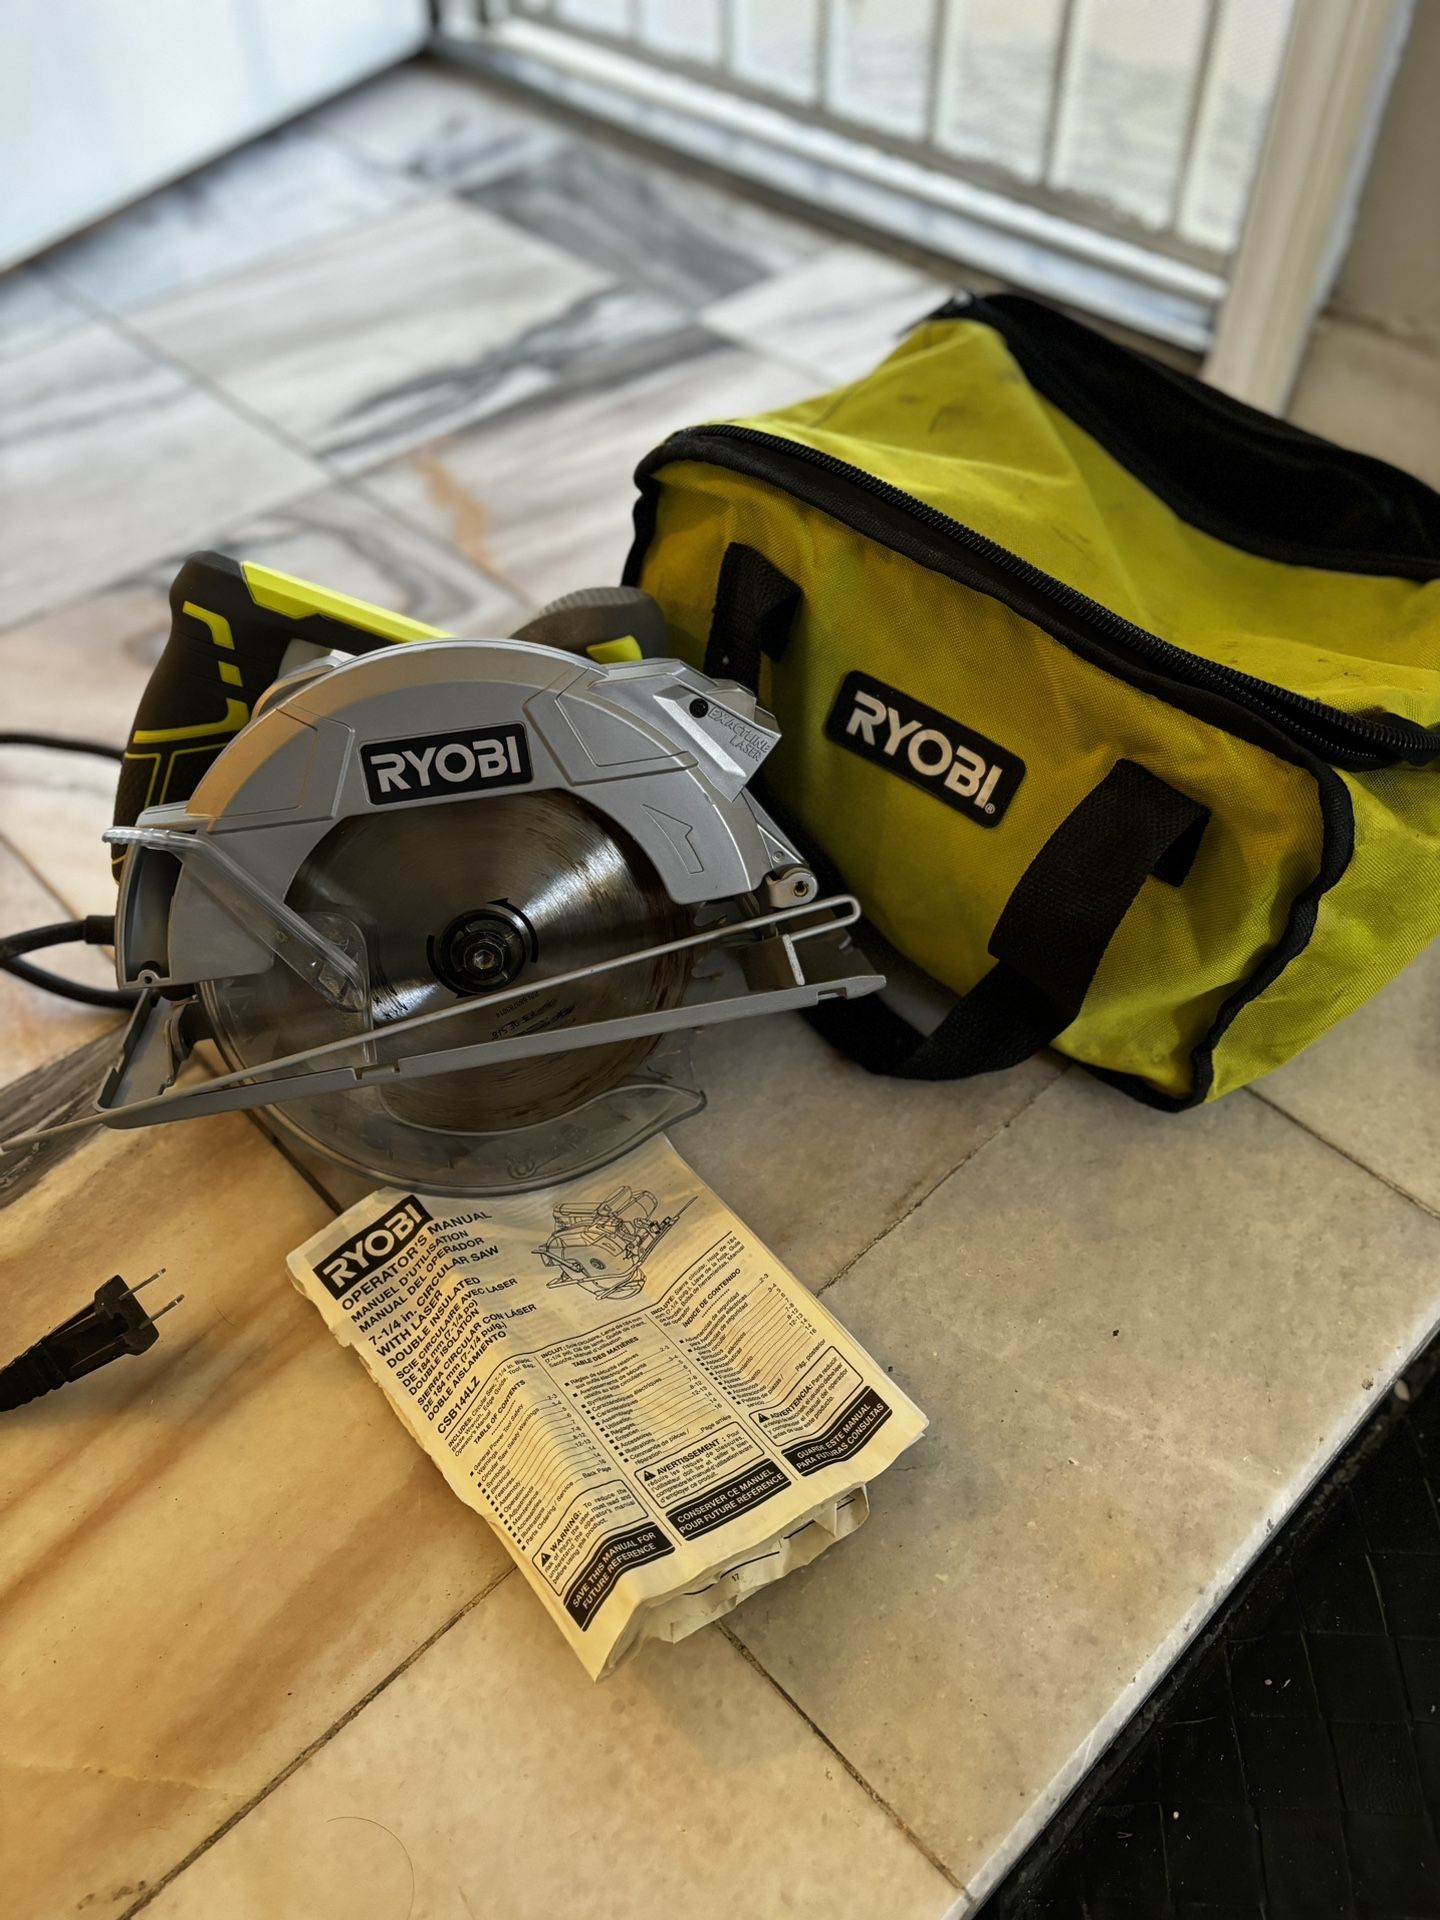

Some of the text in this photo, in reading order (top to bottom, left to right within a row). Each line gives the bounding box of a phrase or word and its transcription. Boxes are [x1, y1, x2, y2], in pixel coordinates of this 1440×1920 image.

[370, 736, 521, 793] RYOBI
[729, 734, 761, 761] LASER
[846, 690, 1002, 808] RYOBI
[323, 1203, 422, 1288] RYOBI
[342, 1211, 492, 1310] OPERATOR'S MANUAL
[351, 1230, 468, 1322] MANUEL D'UTILISATION
[359, 1237, 484, 1332] MANUAL DEL OPERADOR
[369, 1245, 499, 1346] 7-1/4 in. CIRCULAR SAW
[707, 1268, 740, 1300] CONTENIDO
[377, 1291, 443, 1356] WITH LASER
[386, 1276, 480, 1368] DOUBLE INSULATED
[396, 1278, 517, 1379] SCIE CIRCULAIRE AVEC LASER
[403, 1299, 478, 1387] DE 184 mm (7-1/4 po)
[409, 1309, 480, 1395] DOUBLE ISOLATION
[418, 1303, 537, 1406] SIERRA CIRCULAR CON LÁSER
[422, 1321, 507, 1413] DE 184 mm (7-1/4 pulg.)
[427, 1331, 506, 1421] DOBLE AISLAMIENTO
[572, 1357, 592, 1367] TABLE
[606, 1337, 639, 1355] MATIÈRES
[437, 1376, 480, 1433] CSB144LZ
[473, 1422, 491, 1444] TABLE
[498, 1380, 526, 1414] CONTENTS
[482, 1396, 494, 1411] Edge
[508, 1366, 521, 1376] Tool
[770, 1385, 813, 1419] ADVERTENCIA:
[448, 1416, 472, 1448] INCLUDES:
[472, 1395, 487, 1417] Circular
[474, 1448, 491, 1471] General
[489, 1431, 504, 1450] Power
[510, 1404, 524, 1422] Safety
[475, 1411, 492, 1429] Manual
[482, 1458, 499, 1481] Circular
[498, 1447, 509, 1462] Saw
[508, 1431, 520, 1449] Safety
[519, 1408, 540, 1431] Warnings
[796, 1403, 884, 1469] PARA FUTURAS CONSULTAS
[797, 1404, 871, 1459] GUARDE ESTE MANUAL
[477, 1451, 498, 1475] Warnings
[486, 1465, 506, 1489] Symbols
[491, 1469, 511, 1494] Electrical
[656, 1439, 720, 1475] AVERTISSEMENT
[495, 1477, 515, 1500] Features
[500, 1480, 521, 1507] Assembly
[503, 1486, 526, 1512] Operation
[509, 1485, 534, 1520] Adjustments
[512, 1491, 539, 1525] Maintenance
[526, 1529, 539, 1545] Parts
[538, 1506, 557, 1531] Ordering
[597, 1466, 611, 1475] Page
[678, 1469, 774, 1523] CONSERVER CE MANUEL
[679, 1518, 704, 1533] POUR
[704, 1500, 737, 1521] FUTURE
[545, 1561, 554, 1573] risk
[571, 1528, 580, 1537] the
[579, 1512, 591, 1528] user
[606, 1498, 619, 1508] read
[550, 1510, 582, 1552] WARNING:
[594, 1492, 615, 1502] reduce
[549, 1544, 575, 1578] understand
[553, 1564, 568, 1585] before
[567, 1549, 580, 1566] using
[578, 1538, 587, 1551] this
[573, 1532, 656, 1608] SAVE THIS MANUAL FOR
[582, 1543, 656, 1610] FUTURE REFERENCE
[731, 1573, 740, 1582] 17
